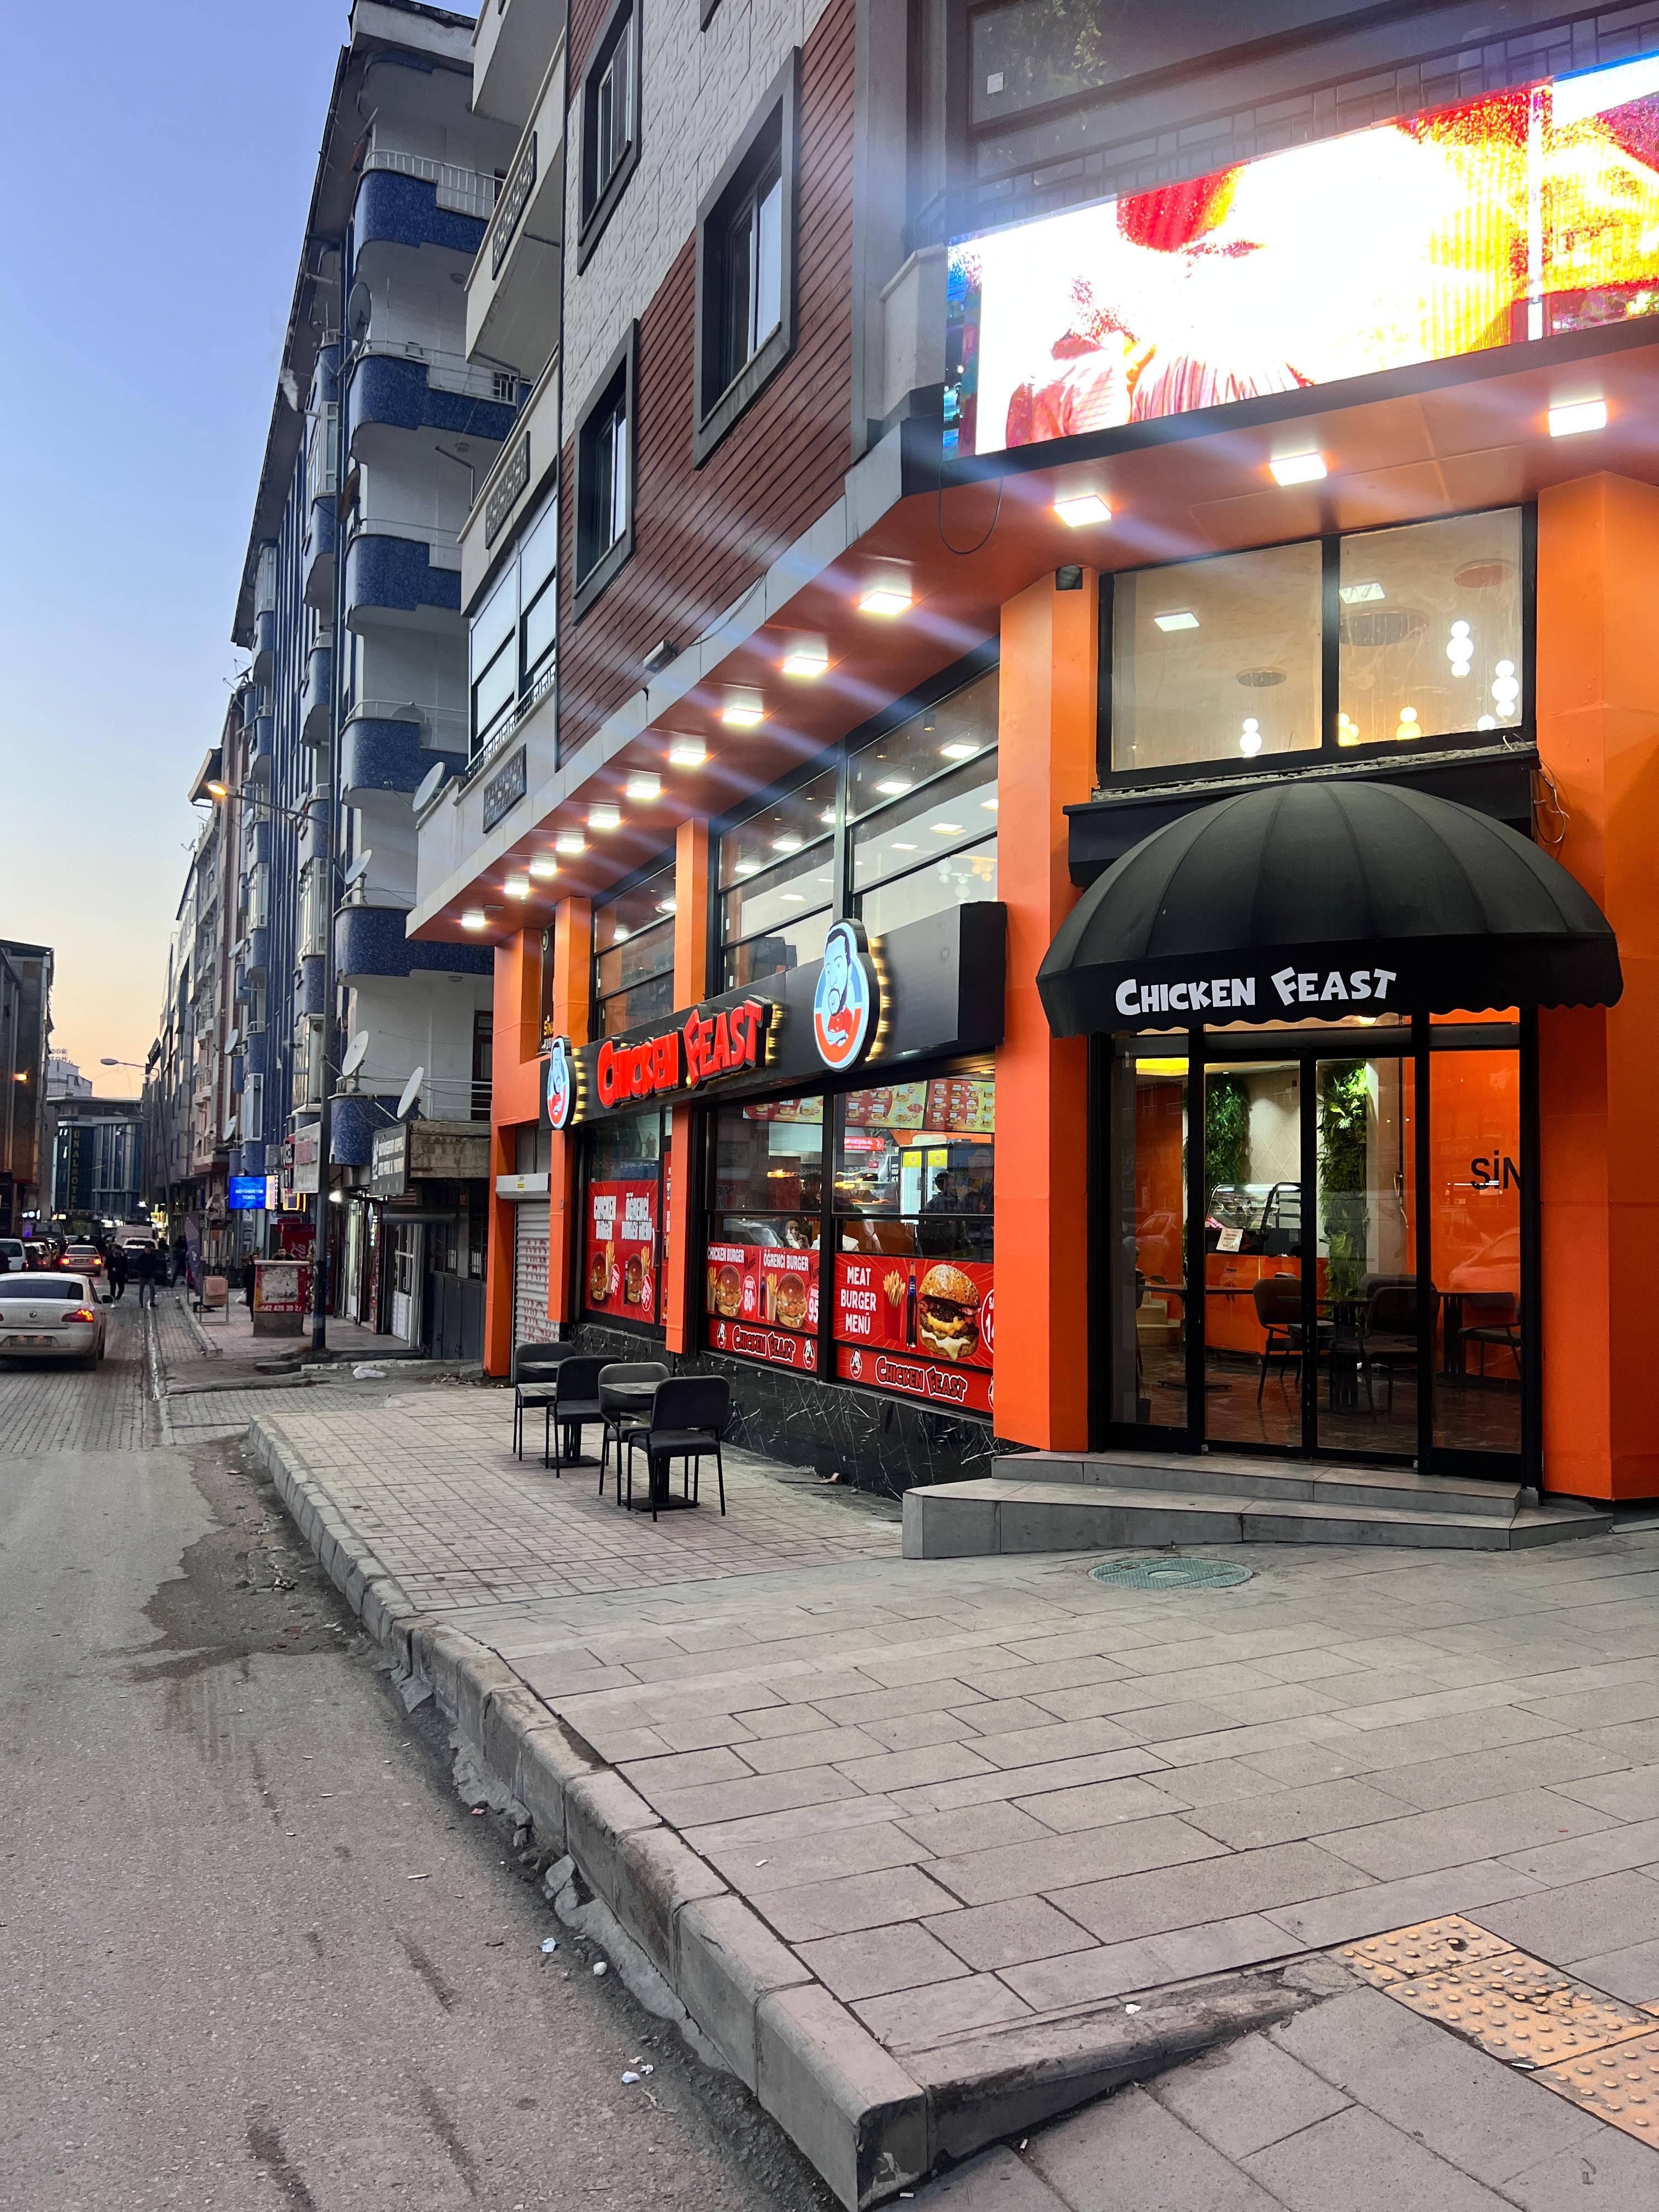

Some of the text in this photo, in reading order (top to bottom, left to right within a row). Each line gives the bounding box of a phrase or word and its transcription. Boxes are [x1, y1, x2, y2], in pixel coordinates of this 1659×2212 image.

[1115, 967, 1396, 1015] CHICKEN FEAST
[597, 1000, 763, 1107] CHICKEN FEAST
[707, 1246, 744, 1263] CHICKEN BURGER
[786, 1255, 809, 1272] BURGER
[847, 1266, 871, 1286] MEAT
[840, 1289, 877, 1312] BURGER
[845, 1312, 871, 1335] MENÜ
[732, 1325, 795, 1363] CHICKEN FEAST
[875, 1356, 968, 1402] CHICKEN FEAST
